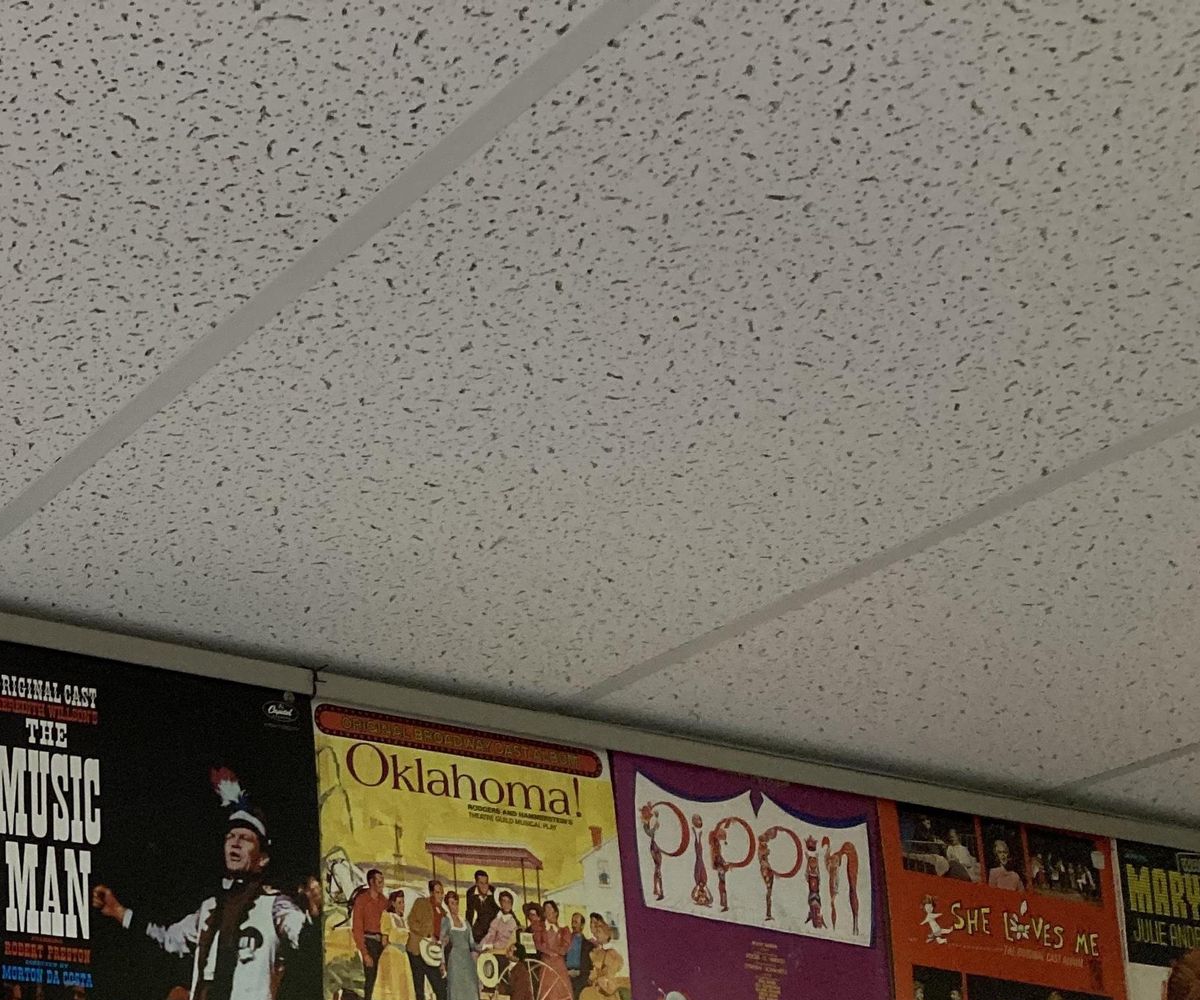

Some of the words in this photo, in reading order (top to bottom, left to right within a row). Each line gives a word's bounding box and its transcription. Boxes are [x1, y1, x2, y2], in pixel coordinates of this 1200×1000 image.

[64, 684, 97, 708] CAST
[25, 717, 67, 748] THE
[346, 742, 582, 818] Oklahoma!
[5, 841, 91, 940] MAN
[1126, 864, 1200, 920] MARY
[950, 903, 992, 935] SHE
[1003, 902, 1064, 949] LOVES
[1076, 932, 1100, 956] ME
[1133, 919, 1168, 946] JULIE
[4, 940, 44, 959] ROBERT
[47, 945, 91, 964] PRESTON
[2, 964, 43, 983] MORTON
[63, 971, 93, 988] COSTA
